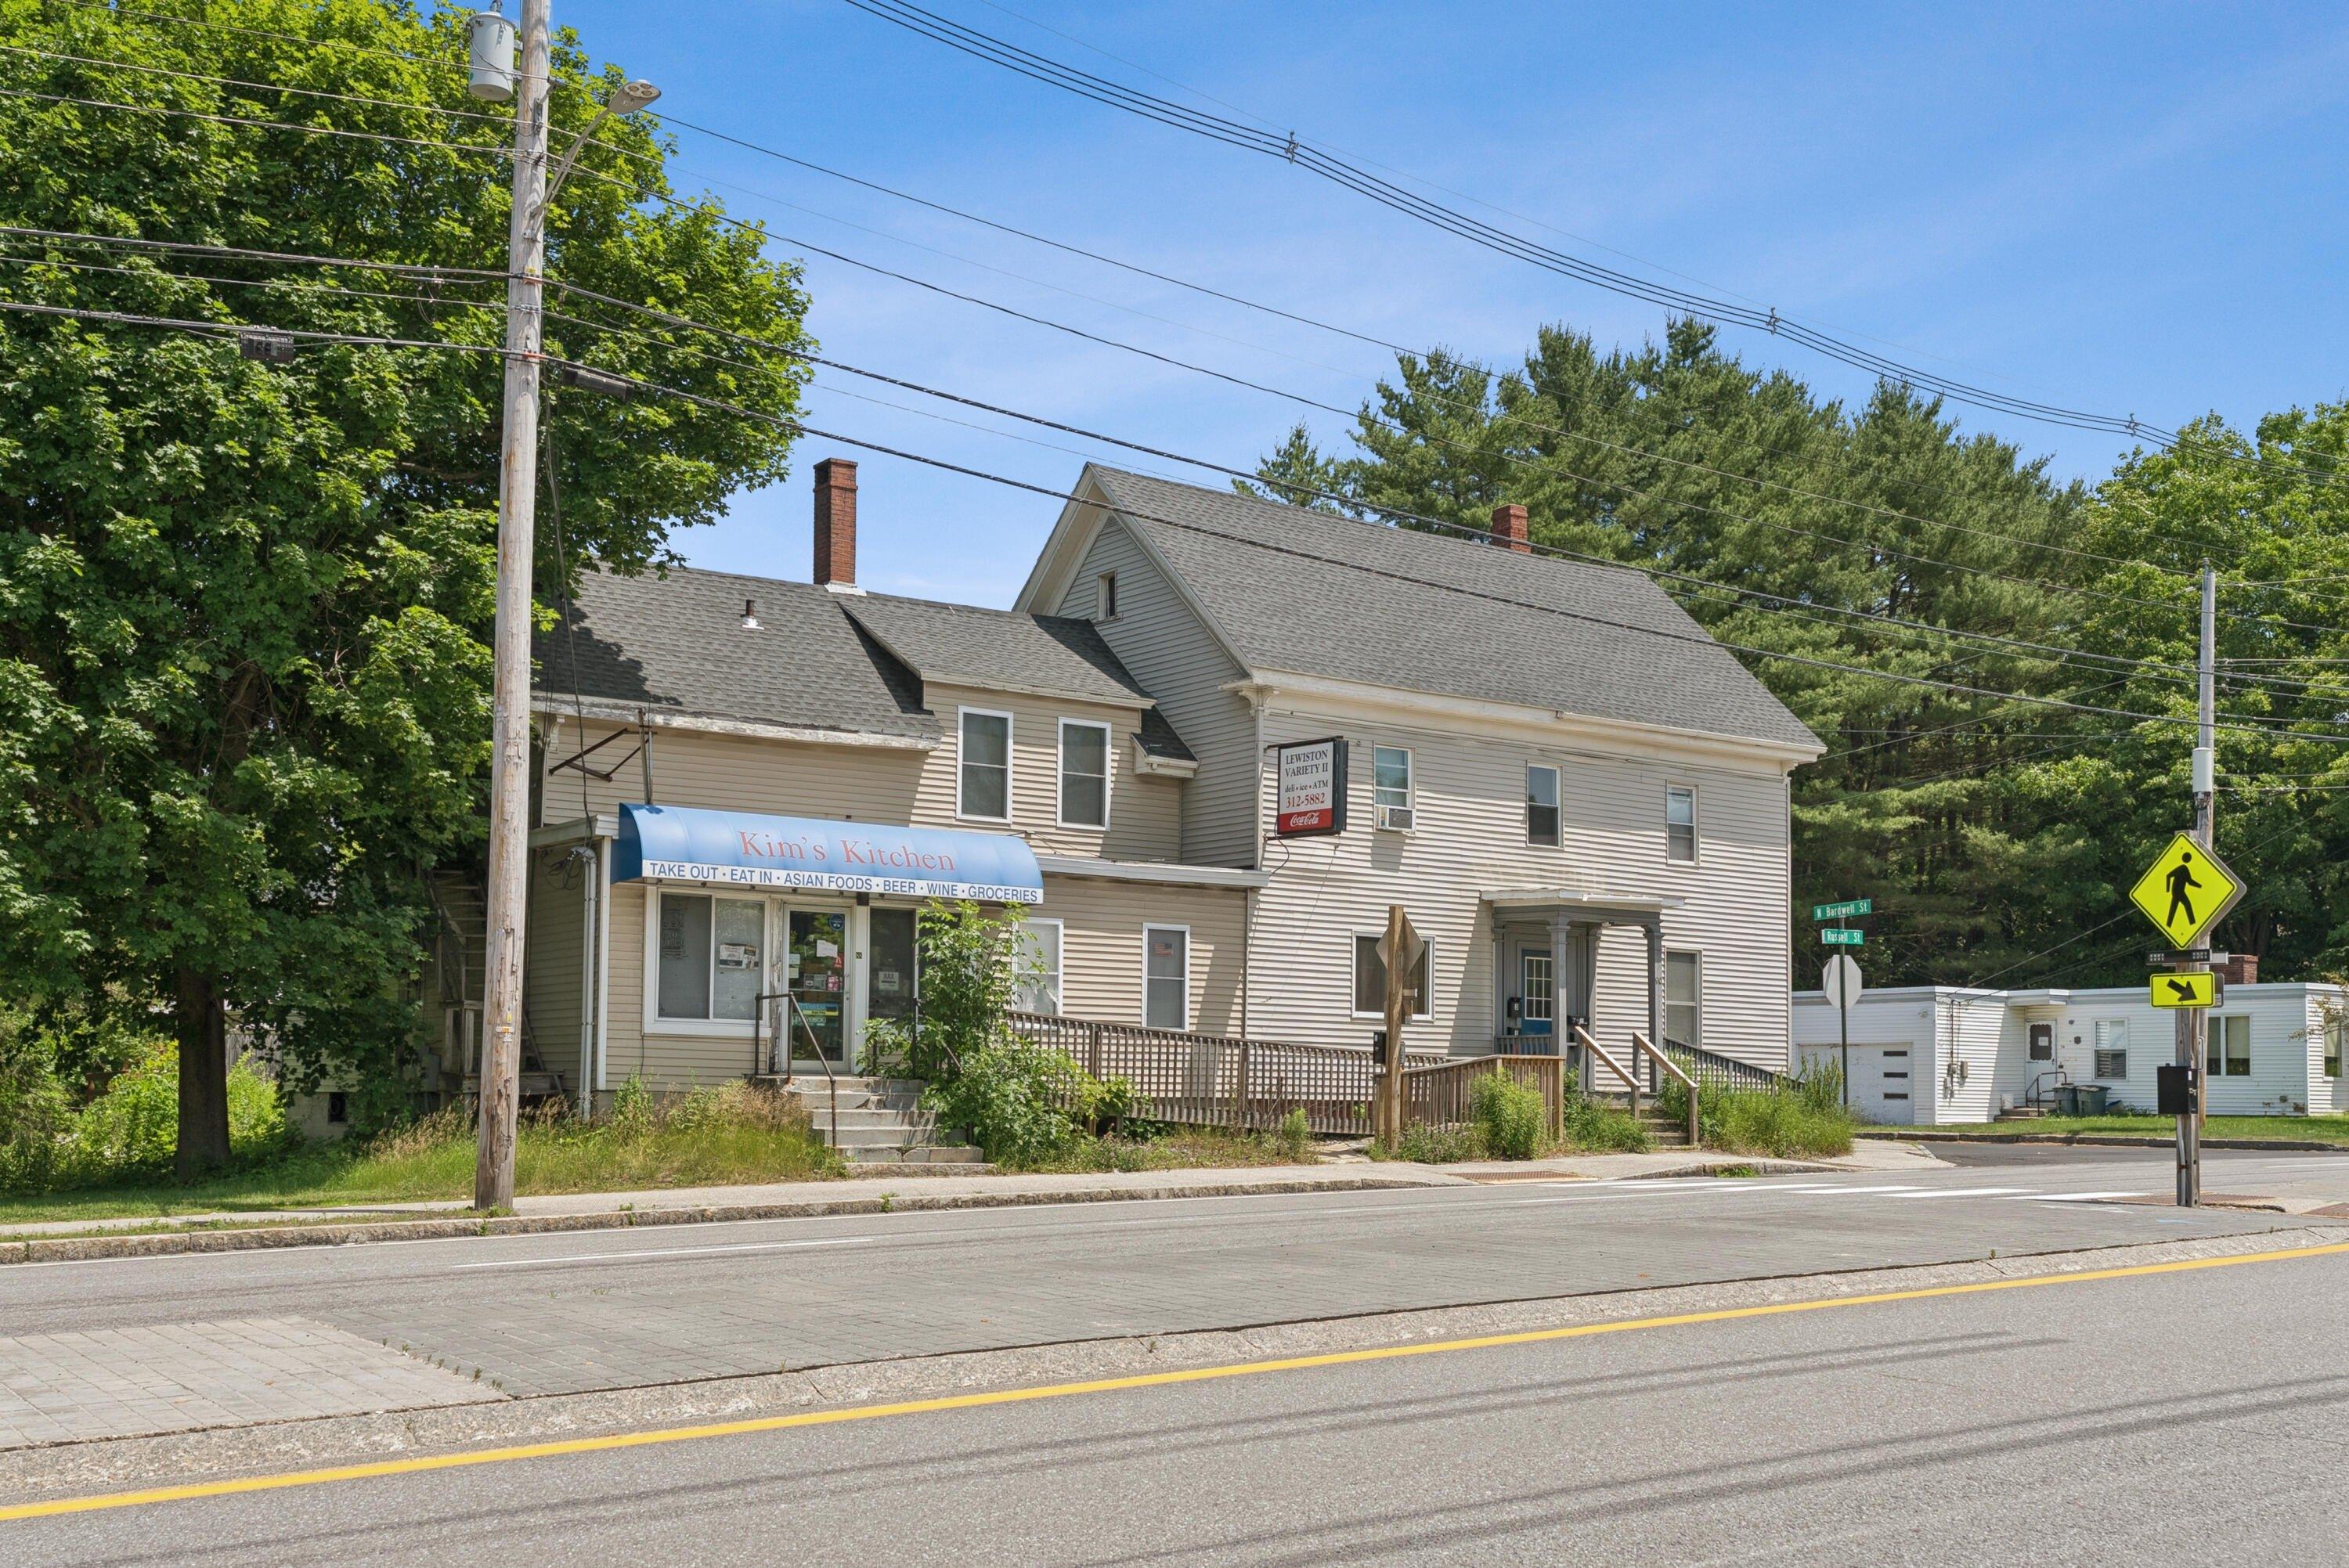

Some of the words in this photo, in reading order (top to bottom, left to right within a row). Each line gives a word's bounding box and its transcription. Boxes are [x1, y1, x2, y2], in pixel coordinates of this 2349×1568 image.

[1286, 749, 1328, 765] LEWISTON
[1285, 764, 1321, 777] VARIETY
[1322, 762, 1328, 773] II
[1285, 784, 1295, 793] deli
[1312, 780, 1329, 789] ATM
[1286, 792, 1326, 809] 312-5882
[738, 831, 827, 861] Kim's
[839, 839, 956, 871] Kitchen
[650, 863, 686, 878] TAKE
[690, 865, 719, 880] OUT
[731, 869, 756, 882] EAT
[760, 871, 772, 884] IN
[784, 873, 824, 888] ASIAN
[828, 876, 872, 891] FOODS
[883, 880, 916, 894] BEER
[927, 883, 958, 896] WINE
[968, 886, 1037, 903] GROCERIES
[1817, 908, 1821, 918] N
[1826, 904, 1855, 917] Bardwell
[1859, 902, 1867, 913] St
[1827, 932, 1848, 941] Russell
[1853, 932, 1860, 942] St
